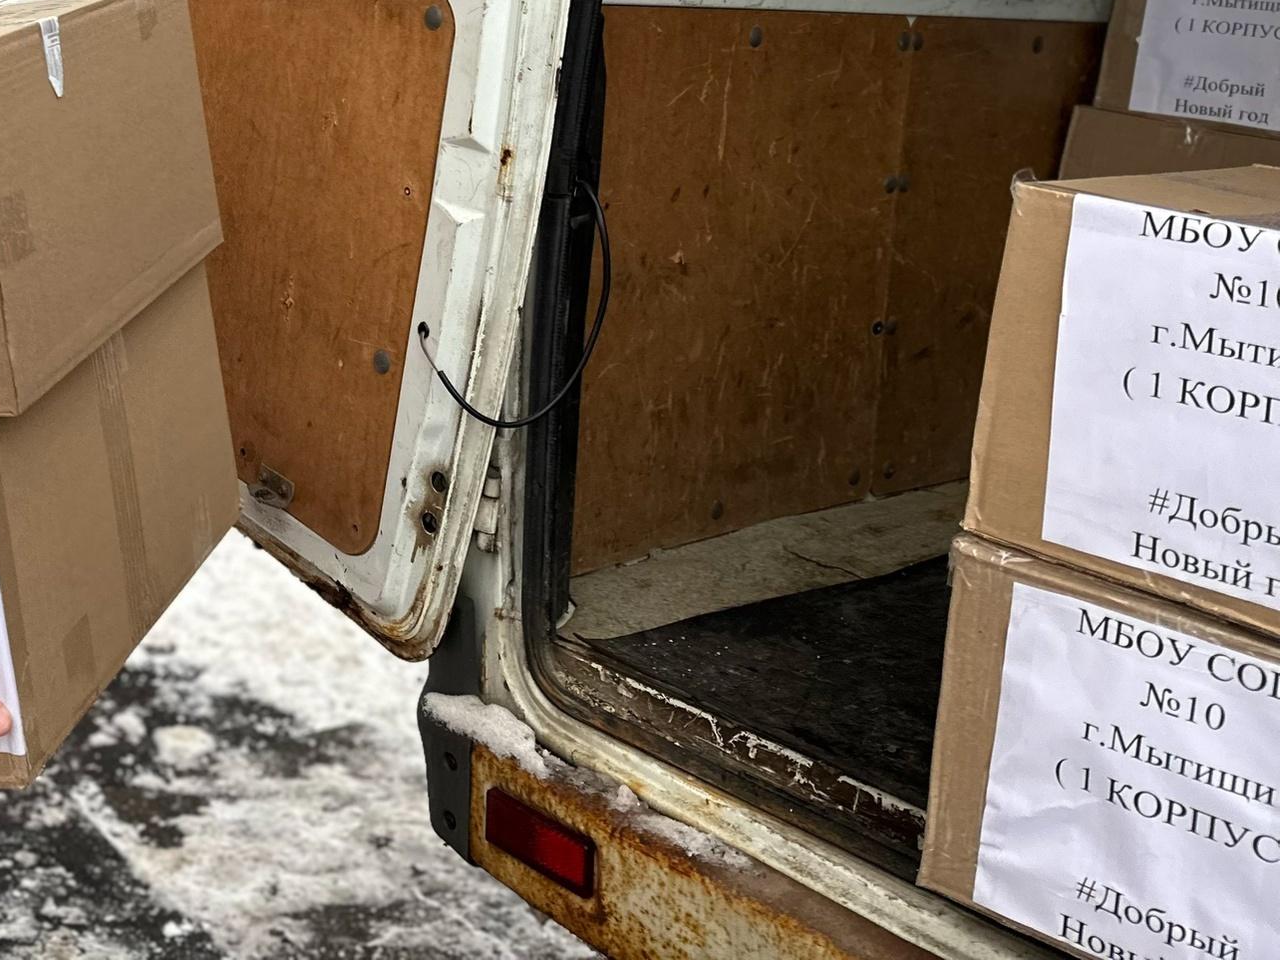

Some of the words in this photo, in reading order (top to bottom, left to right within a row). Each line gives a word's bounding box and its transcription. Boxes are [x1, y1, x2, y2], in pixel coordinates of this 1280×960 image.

[1174, 98, 1233, 119] Новый
[1238, 109, 1270, 125] год
[1183, 75, 1266, 98] #Добрый
[1139, 211, 1266, 253] МБОУ
[1208, 271, 1280, 309] №1
[1130, 530, 1254, 591] Новый
[1075, 607, 1197, 667] МБОУ
[1206, 652, 1280, 701] СО
[1139, 680, 1226, 731] №10
[1081, 721, 1277, 808] г.Мытищи
[1105, 776, 1280, 864] КОРПУС
[1057, 912, 1166, 960] Нов
[1075, 876, 1241, 960] #Добрый
